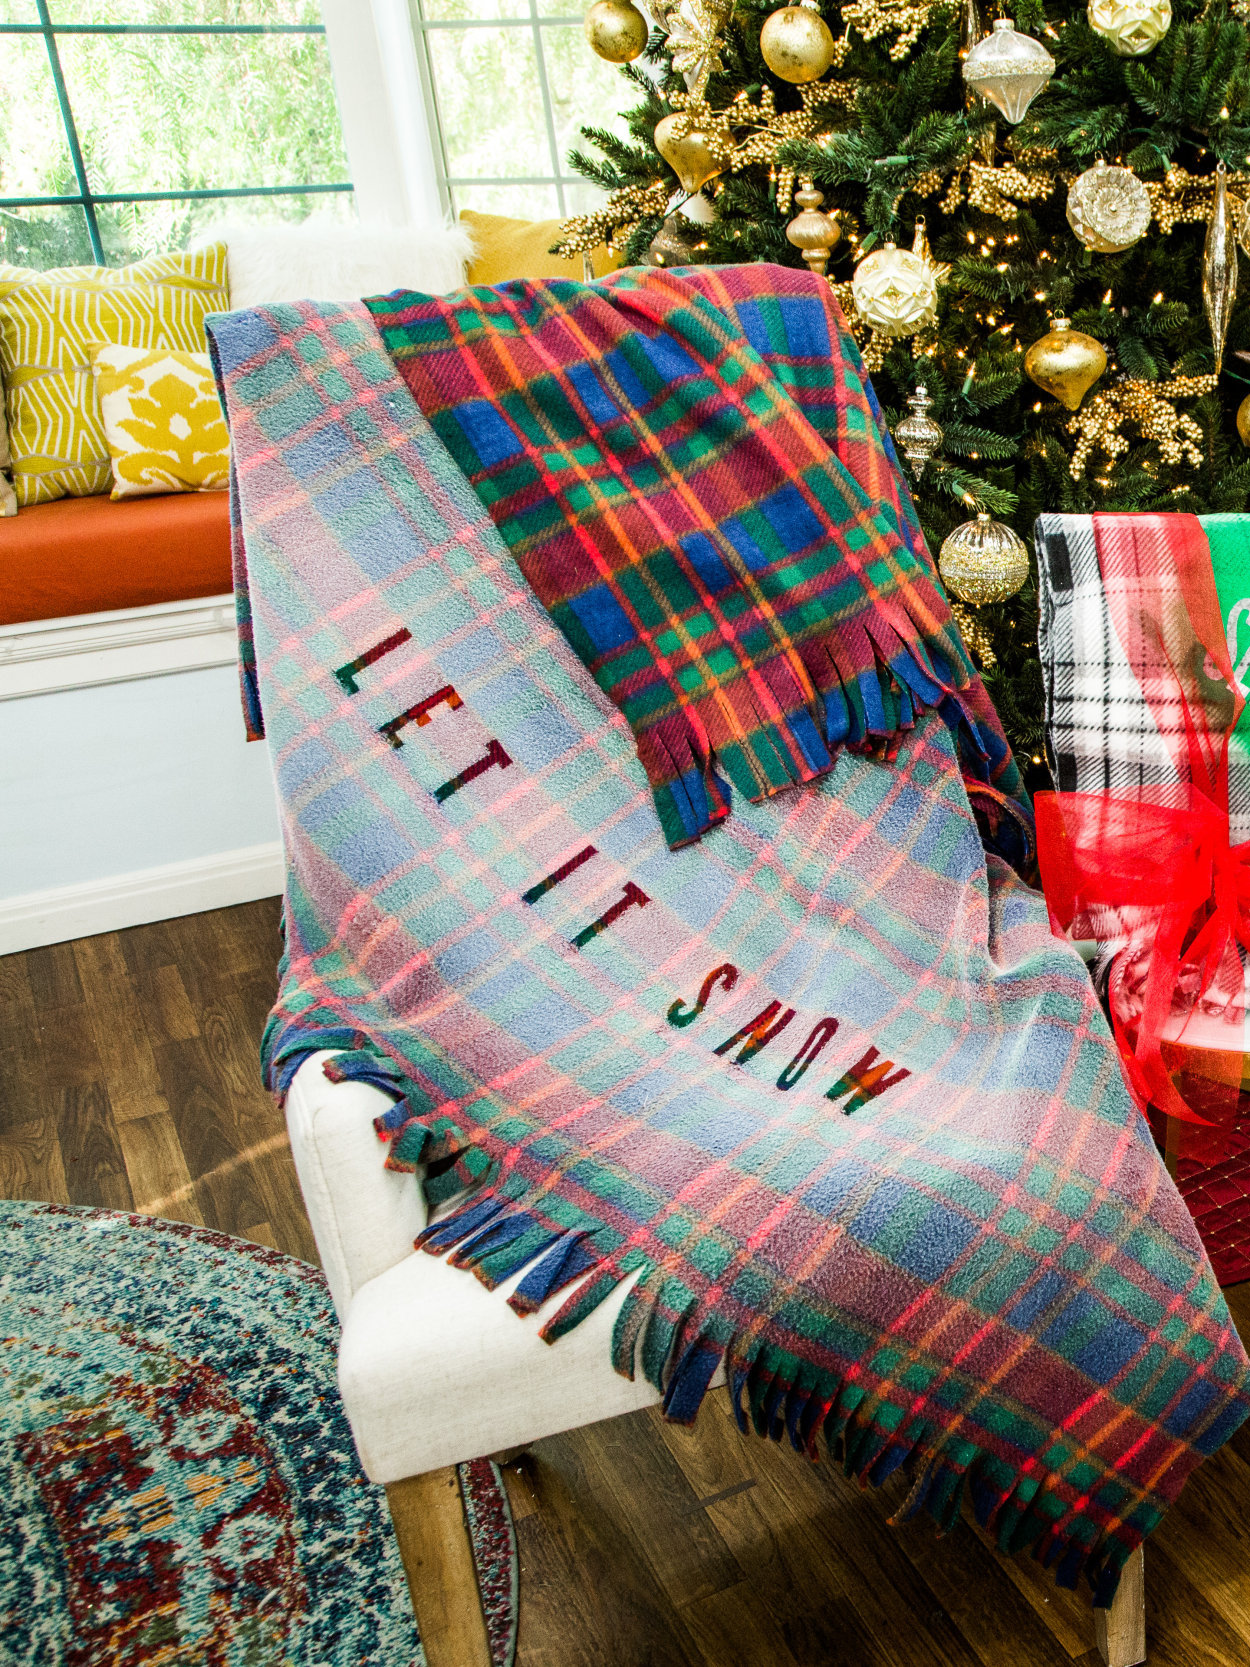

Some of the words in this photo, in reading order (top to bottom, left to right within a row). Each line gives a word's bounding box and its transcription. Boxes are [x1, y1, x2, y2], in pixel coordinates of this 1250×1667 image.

[333, 628, 513, 803] LET
[521, 845, 652, 951] IT
[667, 963, 911, 1115] SNOW
